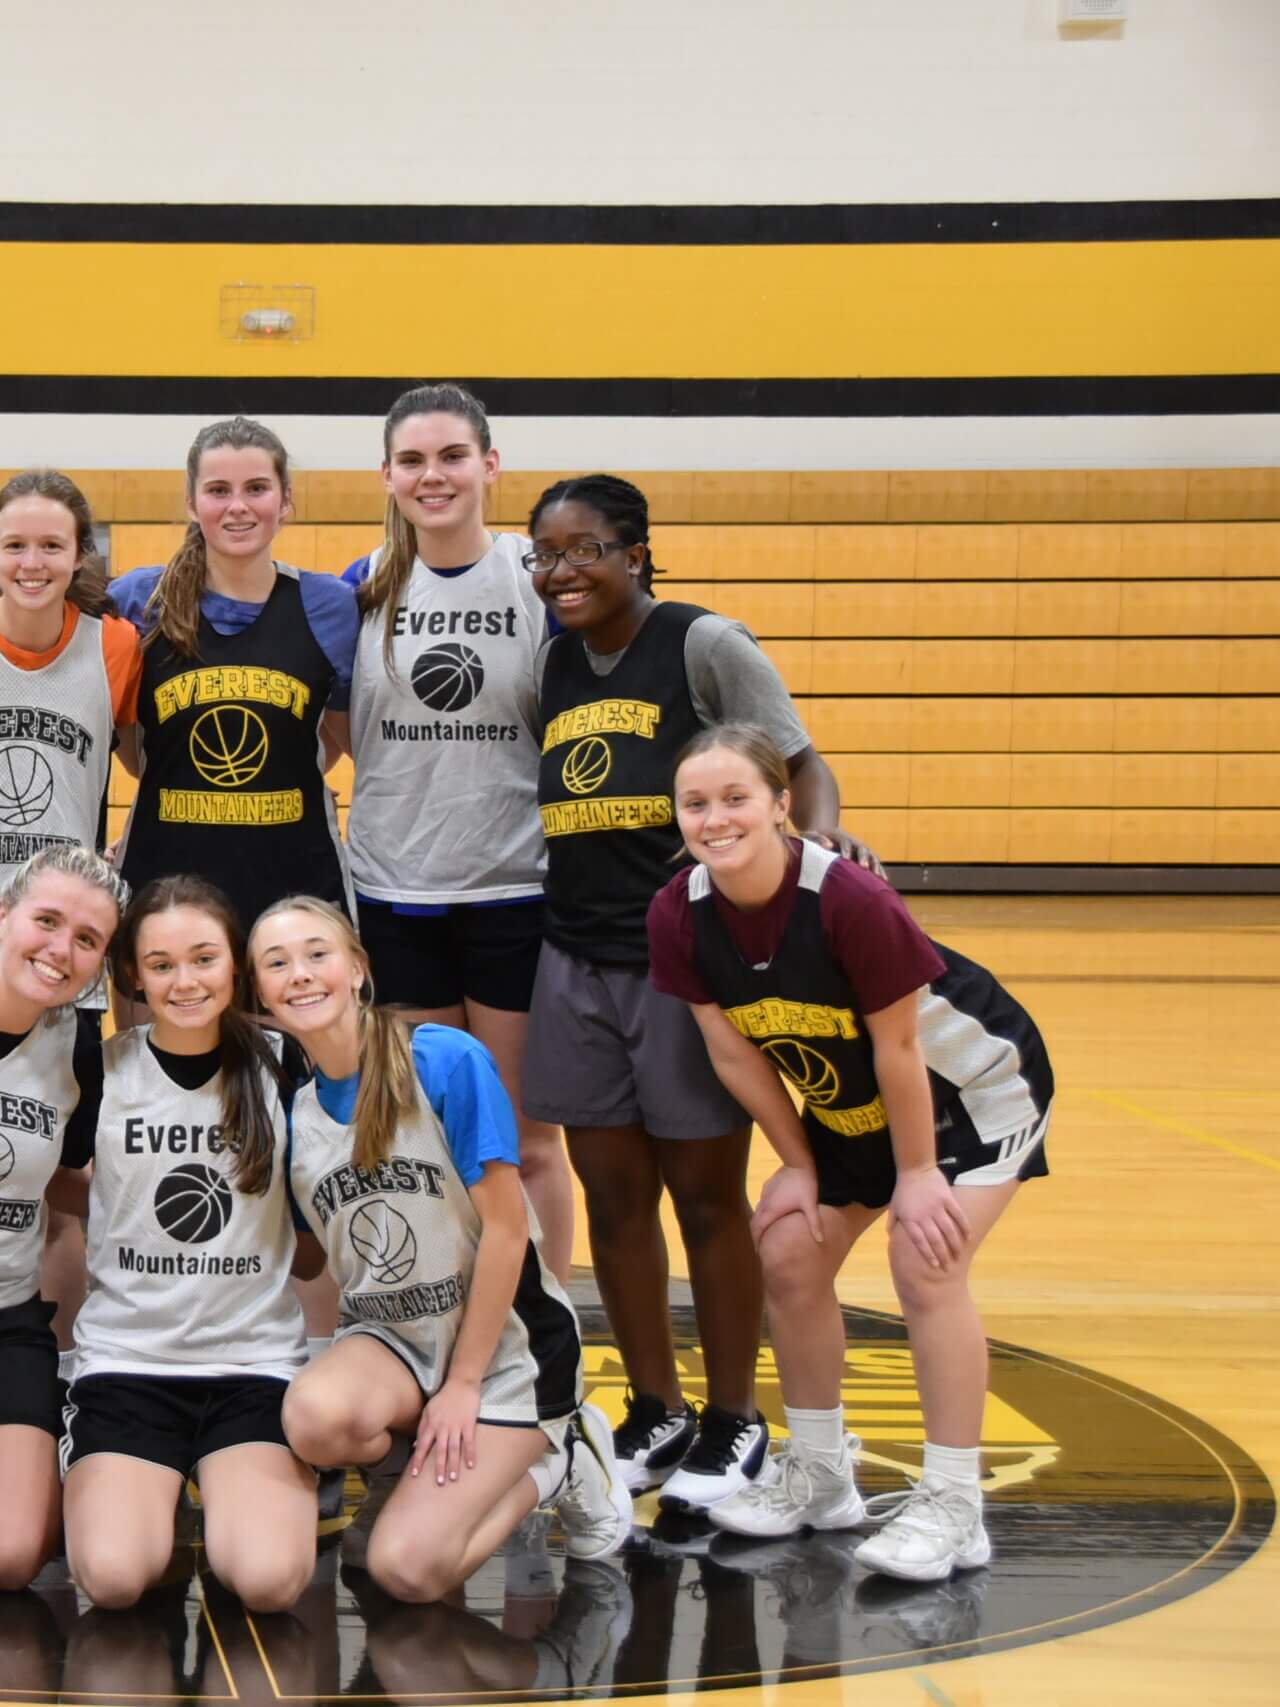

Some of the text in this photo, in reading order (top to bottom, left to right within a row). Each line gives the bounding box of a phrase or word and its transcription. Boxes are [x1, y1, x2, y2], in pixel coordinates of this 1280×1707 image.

[392, 606, 517, 638] Everest
[154, 665, 311, 724] EVEREST
[381, 719, 519, 742] Mountaineers
[541, 698, 661, 756] EVEREST
[158, 788, 303, 825] MOUNTAINEERS
[538, 795, 672, 838] UNTAINEERS
[723, 997, 859, 1040] VEREST
[312, 1155, 445, 1225] EVEREST
[118, 1246, 262, 1276] Mountaineers
